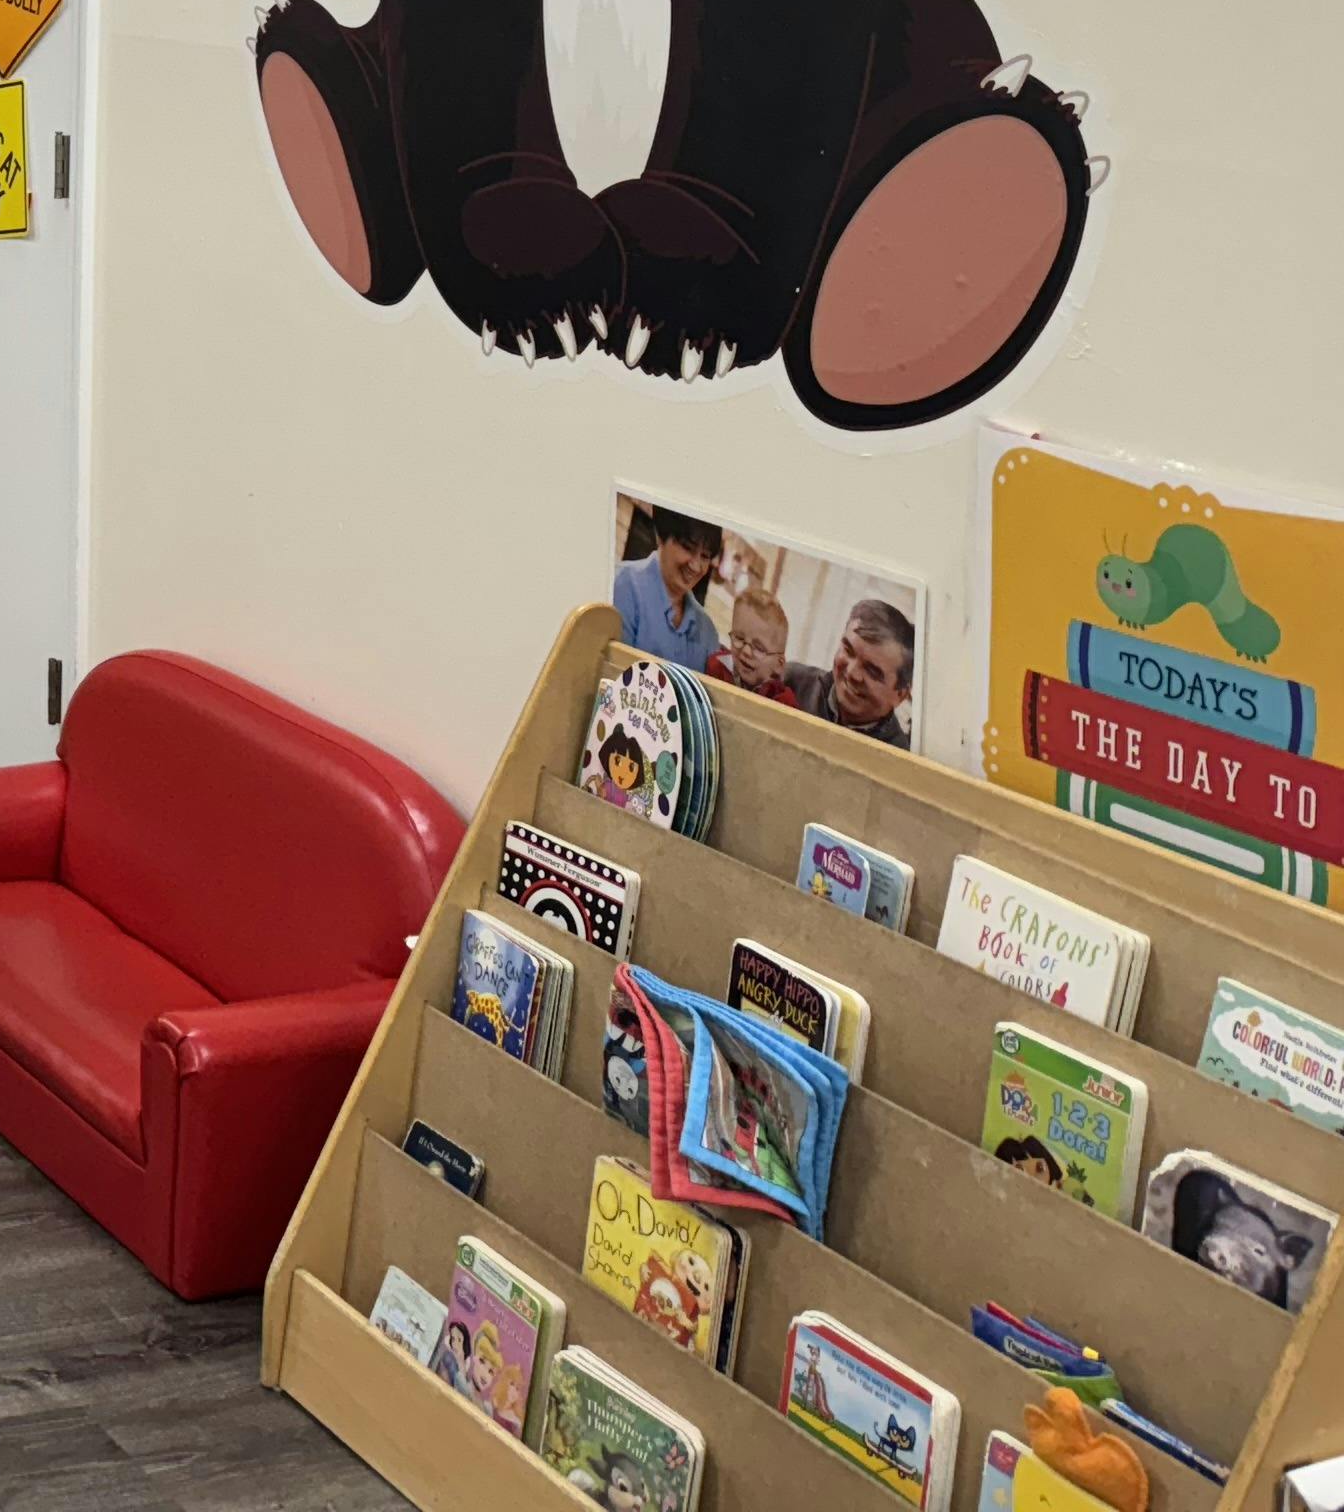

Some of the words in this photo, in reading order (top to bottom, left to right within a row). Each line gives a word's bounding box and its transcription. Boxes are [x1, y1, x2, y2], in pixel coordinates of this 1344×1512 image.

[0, 151, 22, 189] AT
[1118, 650, 1259, 721] TODAY'S
[619, 688, 671, 744] Rainbow
[1071, 709, 1143, 771] THE
[1167, 740, 1243, 804] DAY
[1269, 774, 1318, 830] TO
[961, 877, 992, 914] The
[466, 931, 504, 969] GIRAFFES
[740, 949, 782, 989] HAPPY
[474, 961, 509, 997] DANCE
[737, 972, 782, 1011] ANGRY
[784, 999, 819, 1035] DUCK
[1232, 1020, 1289, 1066] COLORFUL
[637, 1193, 701, 1248] David!
[593, 1221, 633, 1266] David
